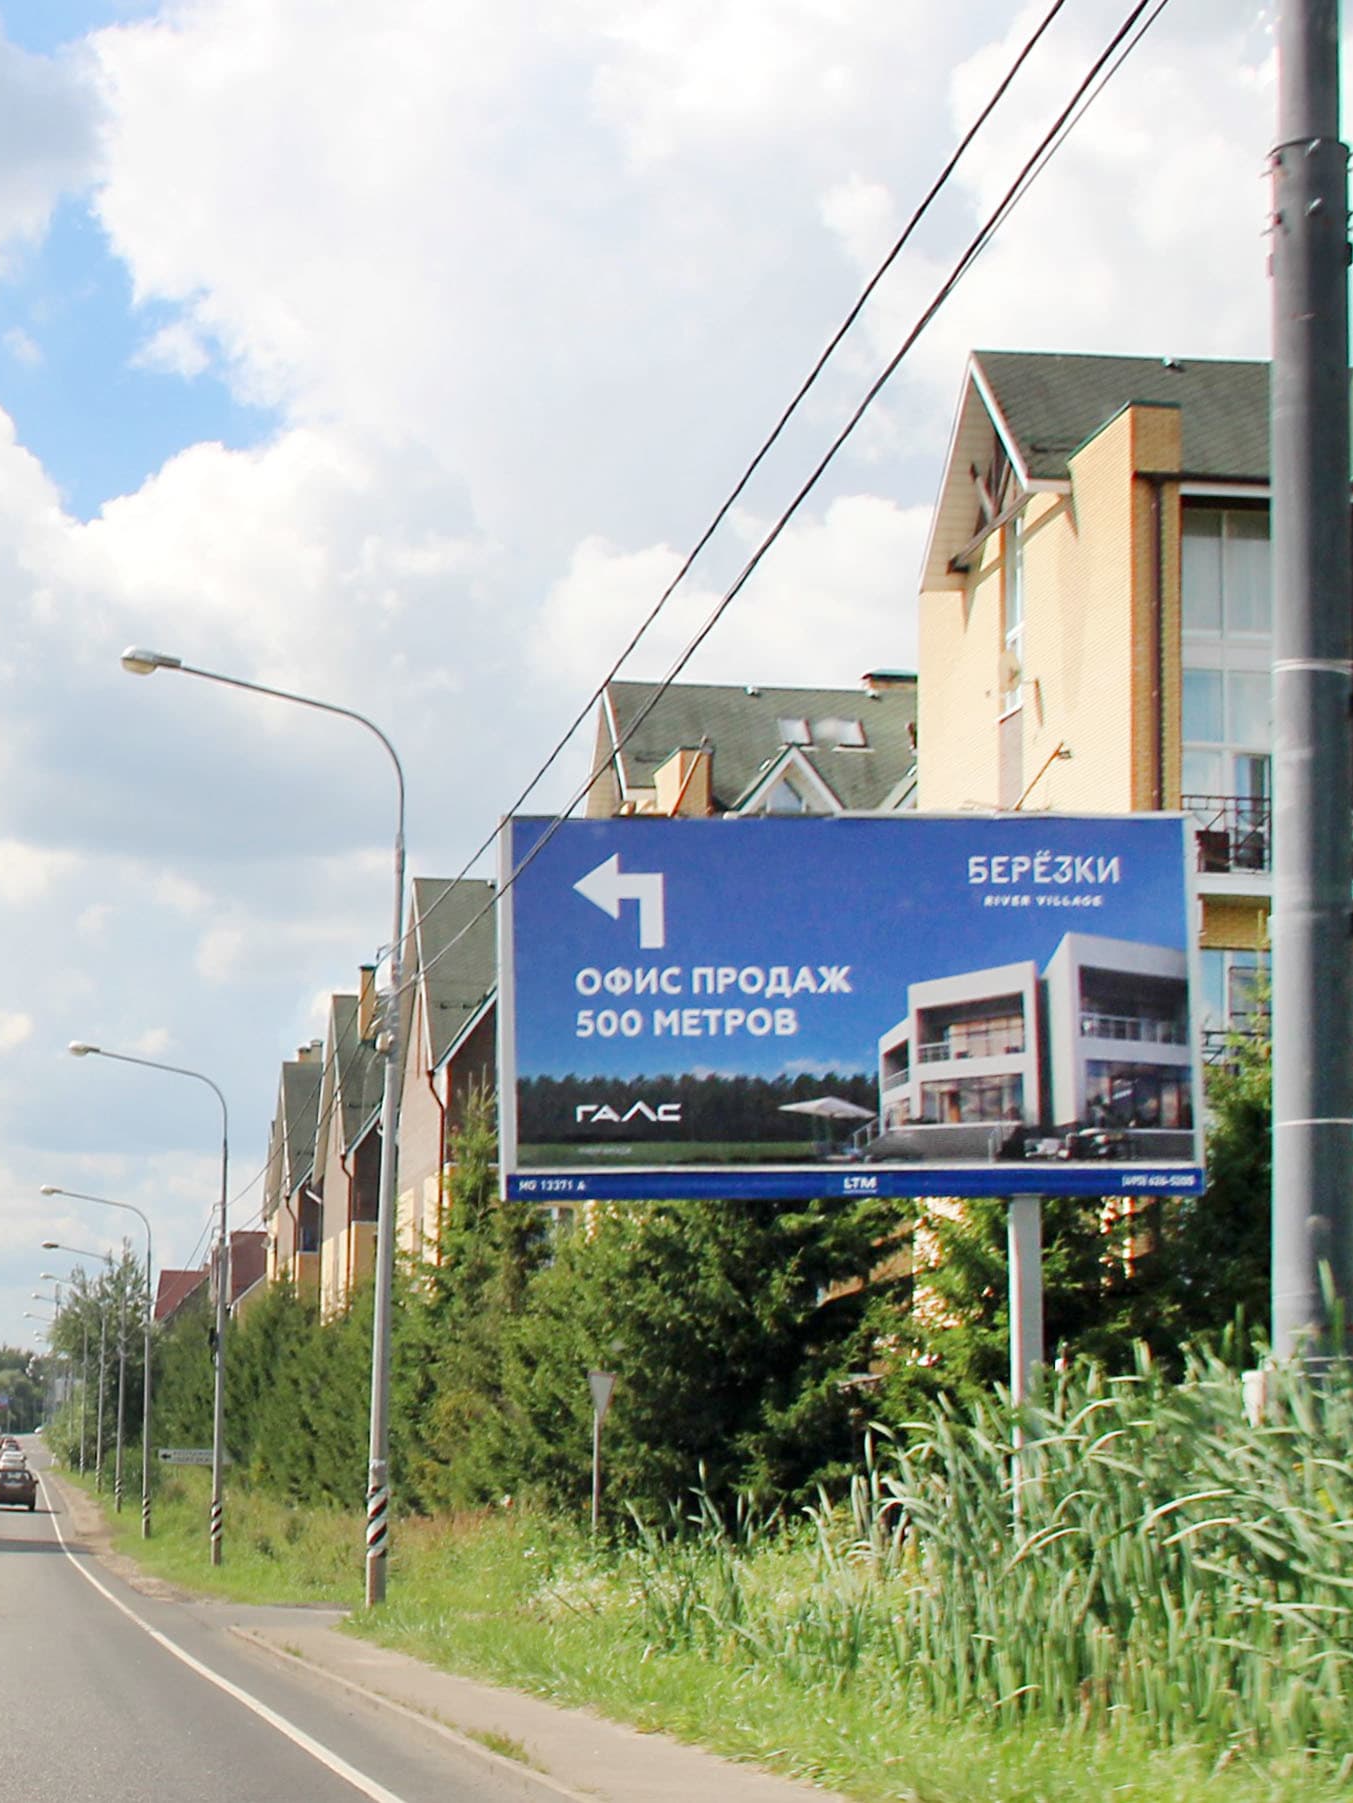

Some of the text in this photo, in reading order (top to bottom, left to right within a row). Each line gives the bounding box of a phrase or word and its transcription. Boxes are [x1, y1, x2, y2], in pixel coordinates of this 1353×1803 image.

[968, 850, 1121, 884] БЕРЁЗКИ
[983, 895, 1103, 907] RIVER VILLAGE
[575, 965, 853, 998] ОФИС ПРОДАЖ
[575, 1008, 799, 1038] 500 МЕТРОВ
[843, 1176, 878, 1189] LTM
